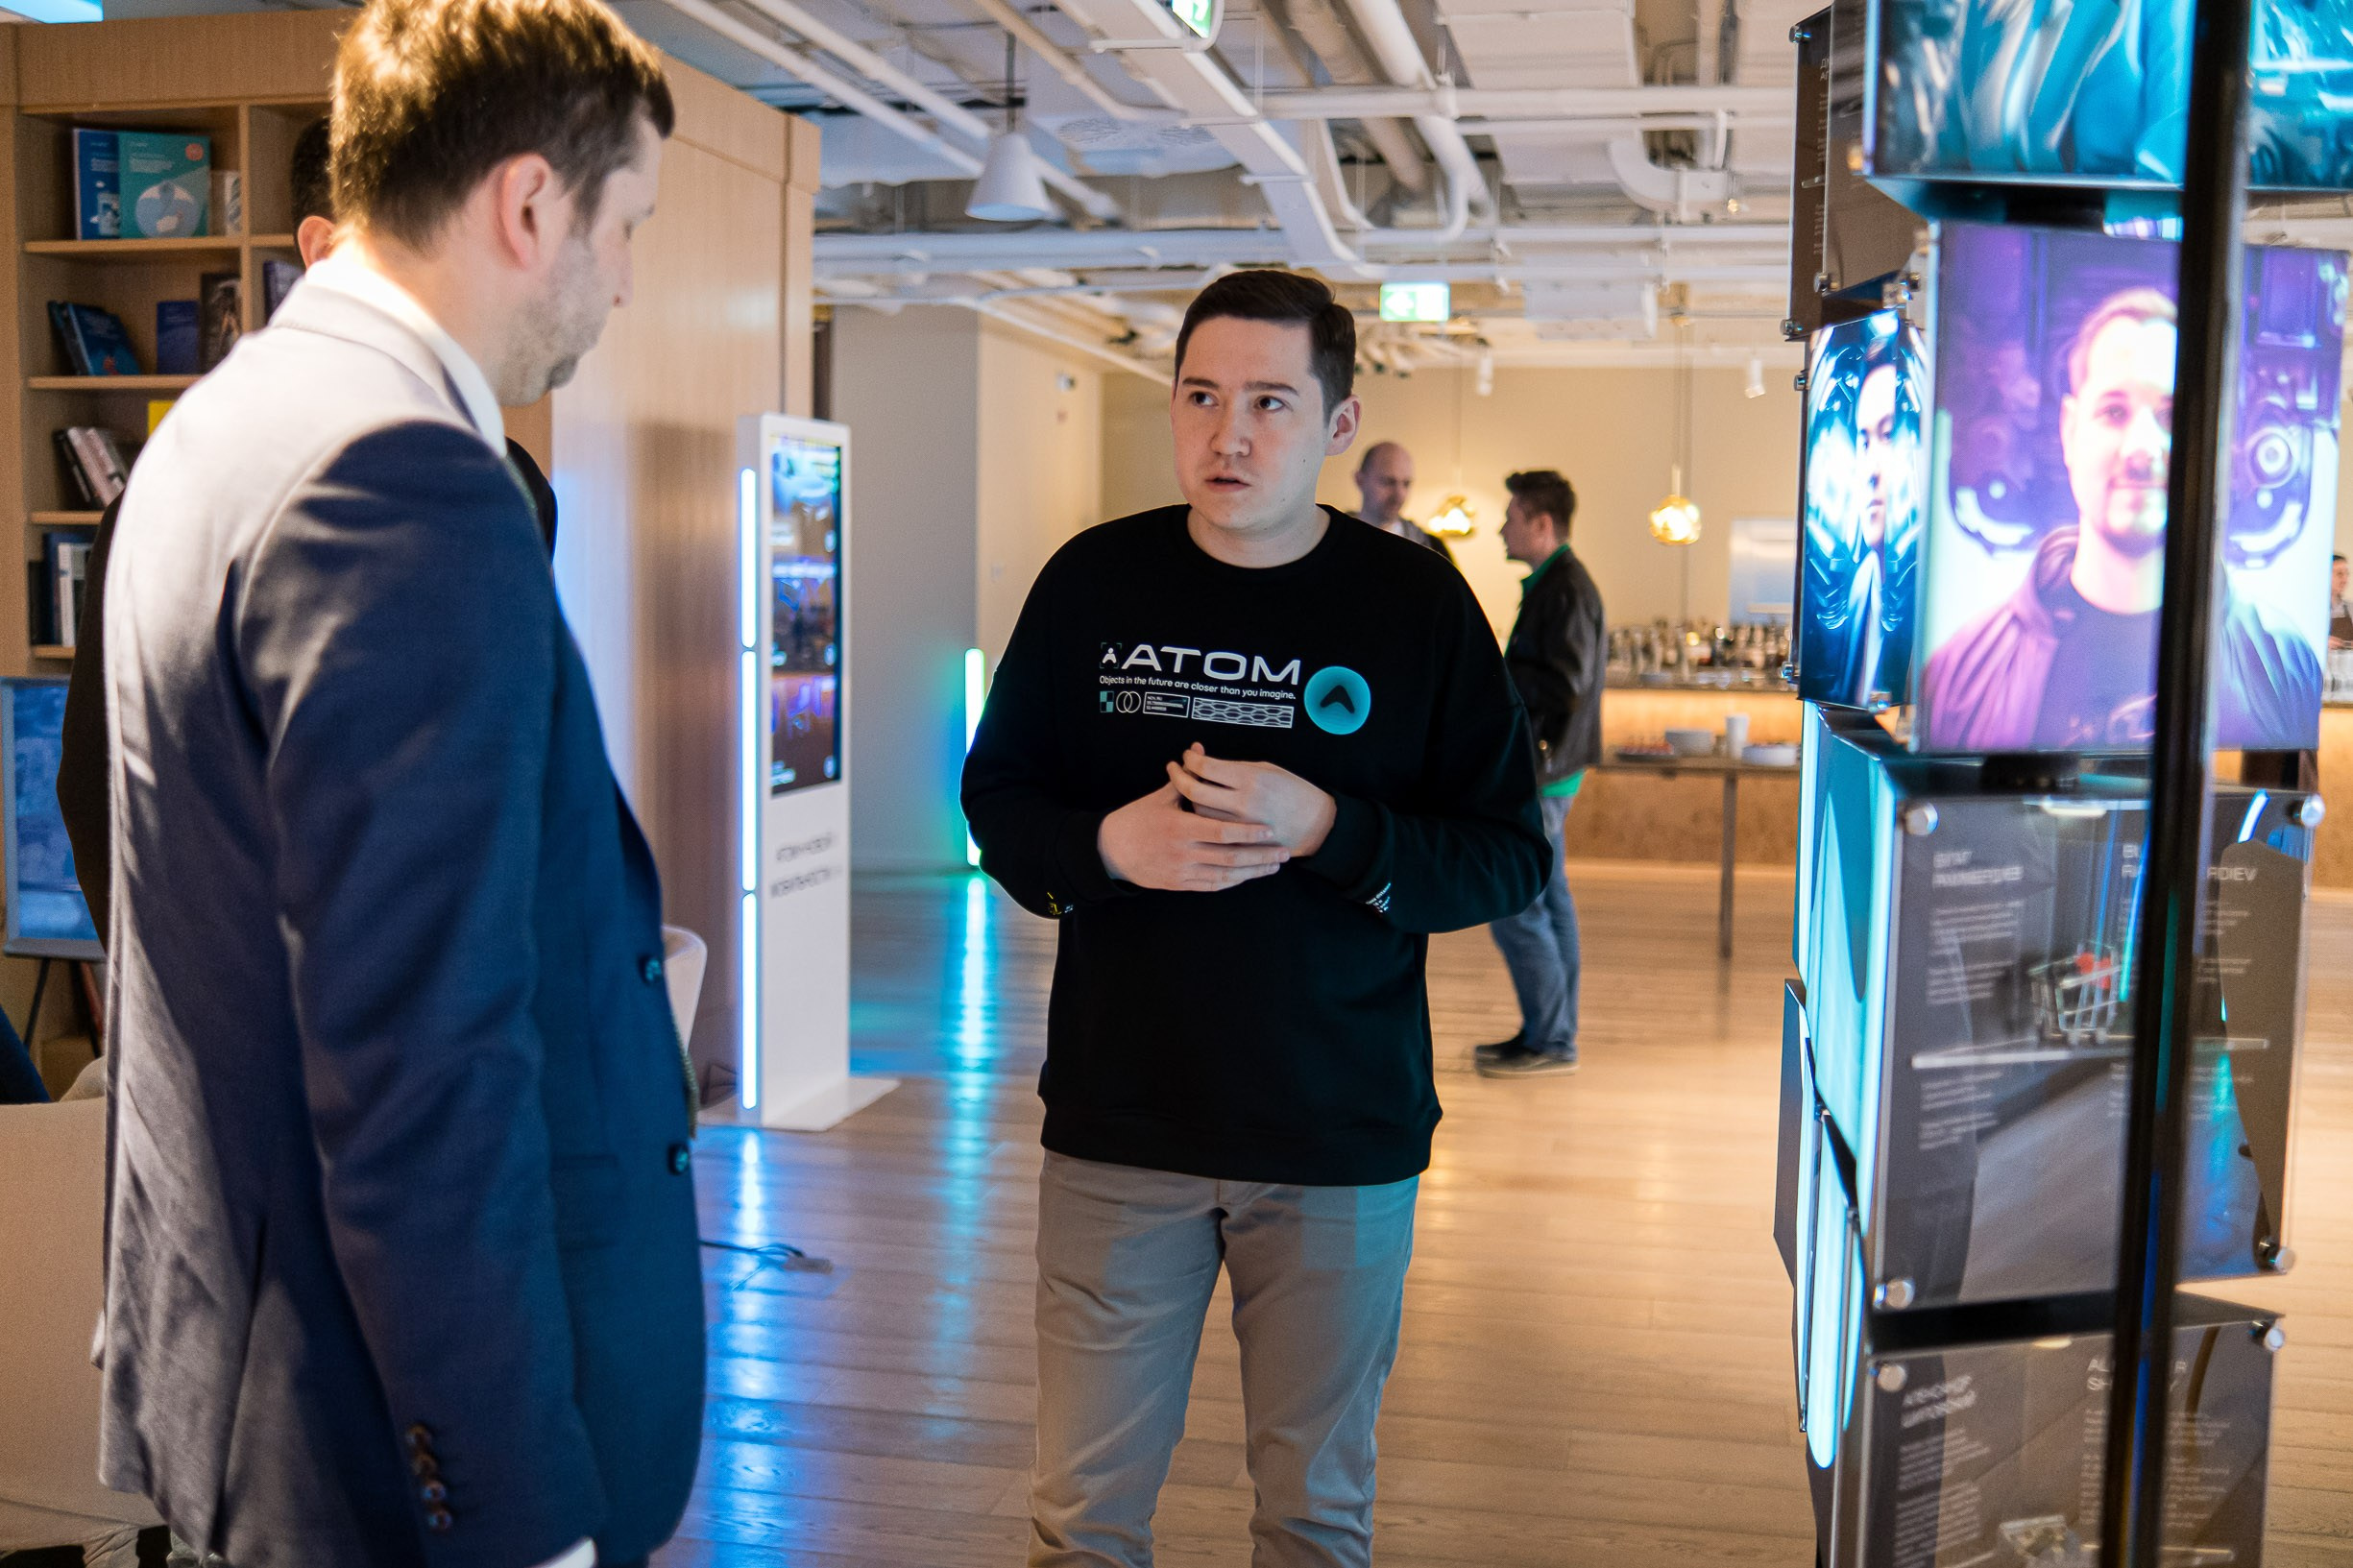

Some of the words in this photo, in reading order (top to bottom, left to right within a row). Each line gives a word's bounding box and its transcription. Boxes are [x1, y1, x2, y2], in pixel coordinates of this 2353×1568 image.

[1121, 643, 1301, 686] ATOM
[1099, 675, 1125, 686] Objects
[1148, 676, 1174, 687] future
[1191, 682, 1219, 692] closer
[1220, 686, 1241, 695] than
[1242, 689, 1258, 698] you
[1259, 688, 1297, 700] imagine.
